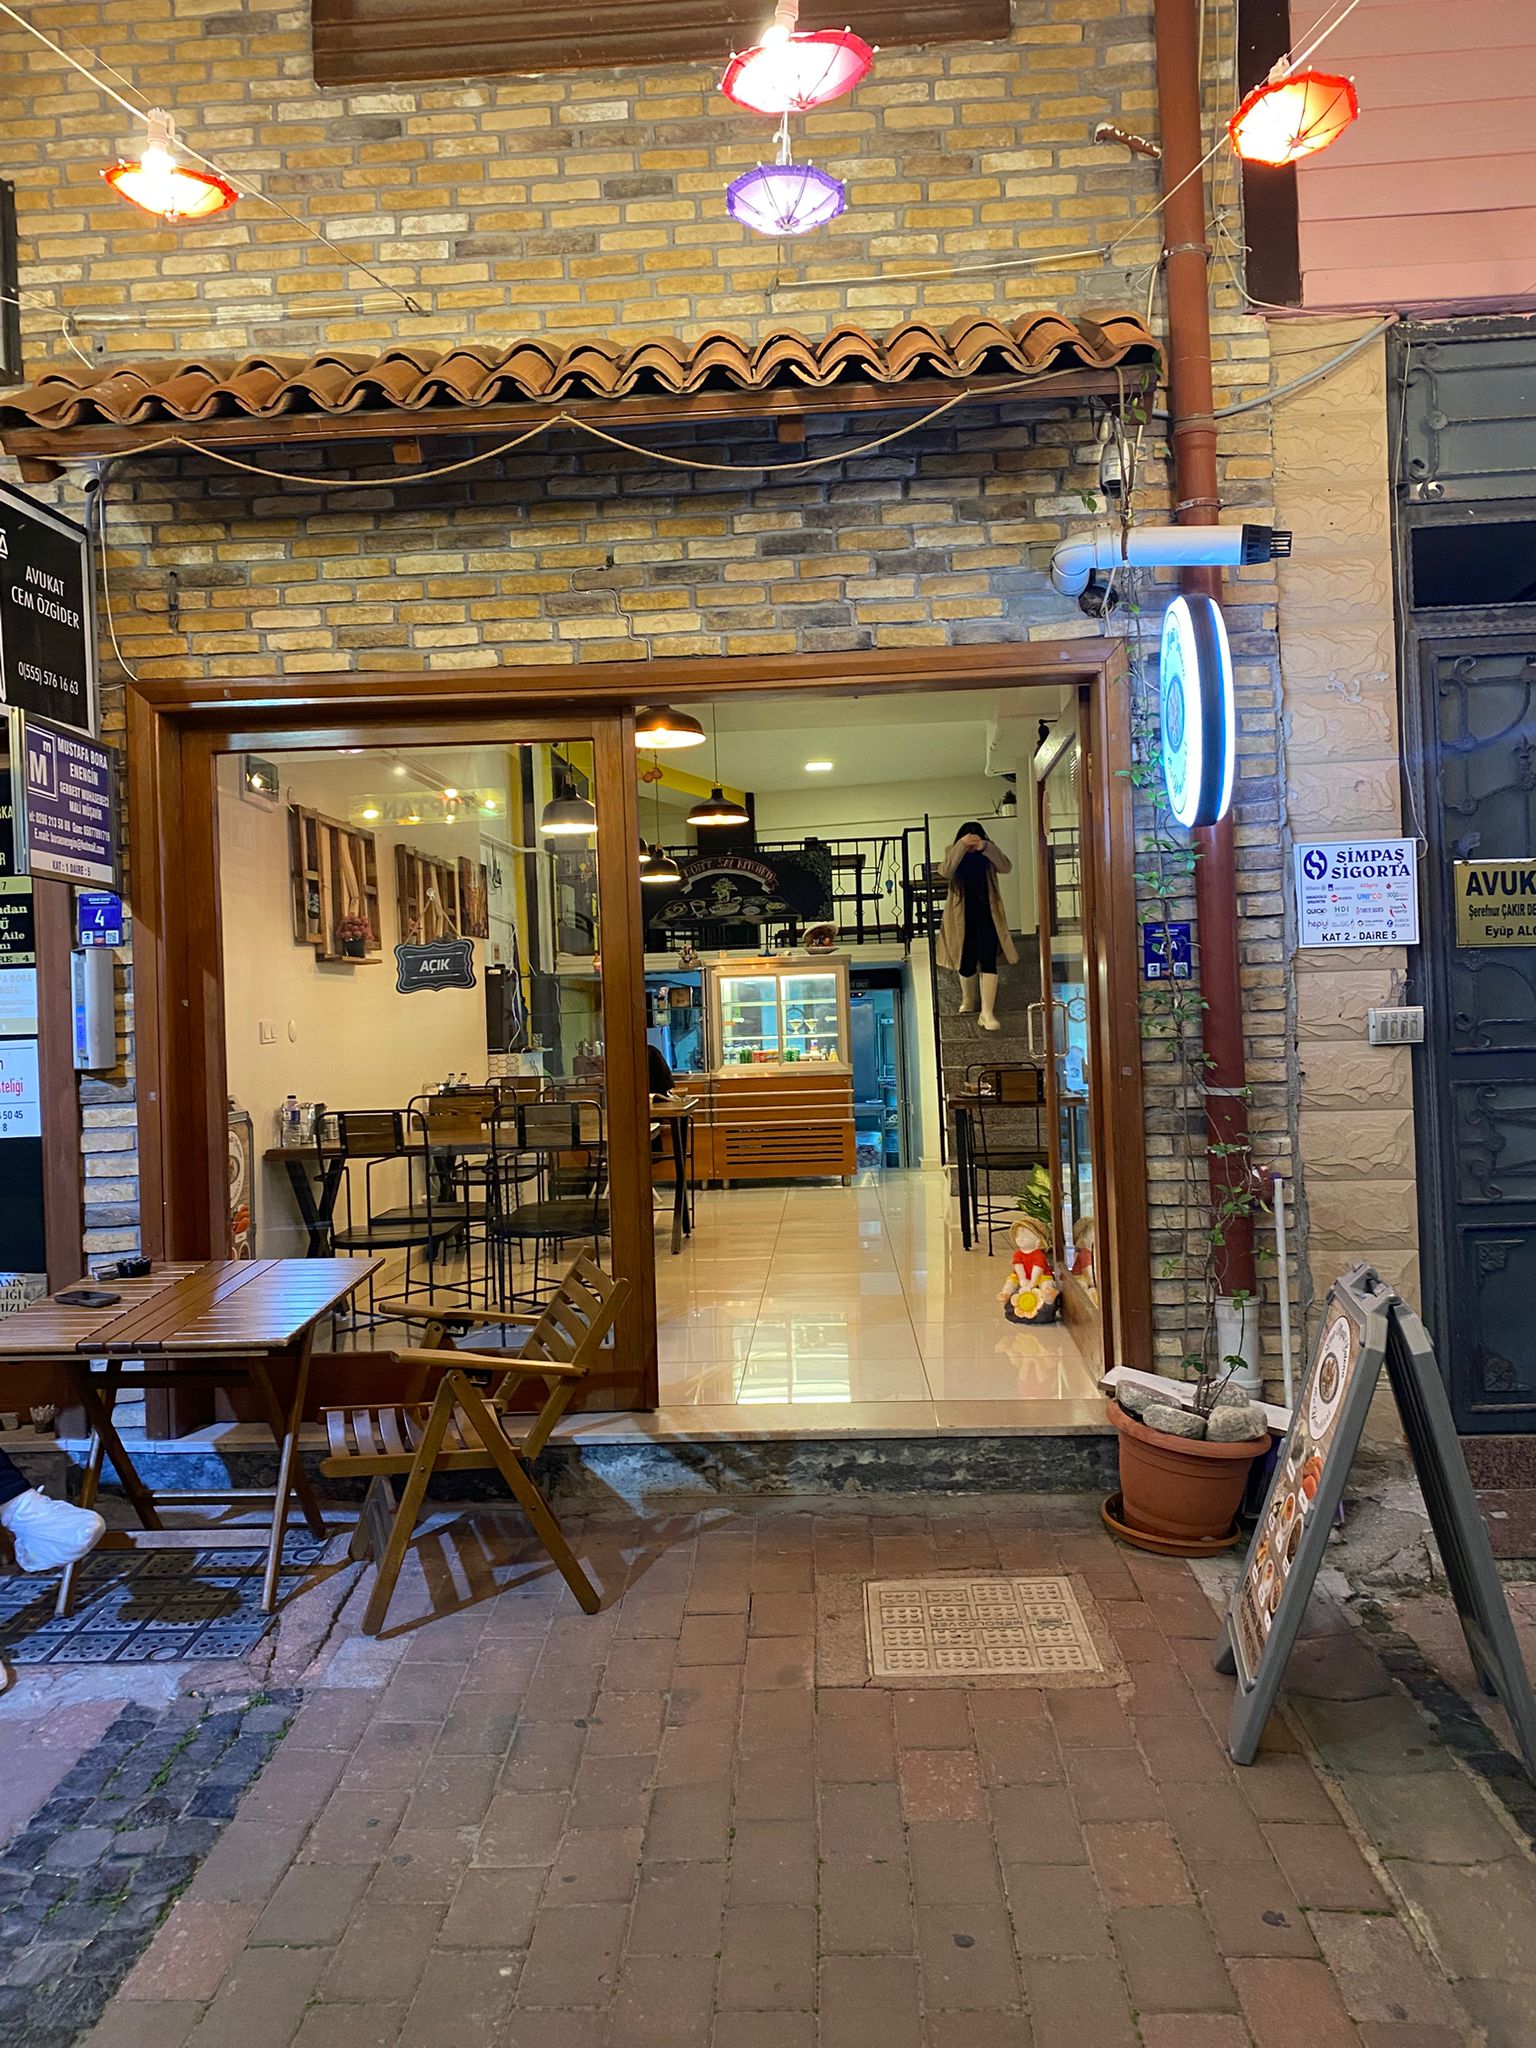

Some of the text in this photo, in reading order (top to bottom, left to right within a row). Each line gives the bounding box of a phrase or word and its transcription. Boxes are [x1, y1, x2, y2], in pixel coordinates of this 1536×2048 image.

[25, 565, 65, 597] AVUKAT
[11, 585, 80, 630] CEM ÖZGİDER
[18, 661, 79, 695] 0(555) 576 16 63
[57, 737, 108, 770] MUSTAFA BORA
[29, 750, 48, 787] M
[59, 781, 81, 798] SERBEST
[1336, 847, 1405, 865] SİMPAŞ
[52, 860, 62, 871] KAT
[1331, 863, 1411, 879] SİGORTA
[2, 881, 7, 891] 7
[94, 909, 105, 927] 4
[1501, 903, 1526, 919] ÇAKIR
[2, 931, 25, 941] Aile
[1322, 932, 1341, 942] KAT
[1344, 932, 1350, 941] 2
[1391, 931, 1397, 940] 5
[1485, 925, 1514, 938] Eyüp
[22, 954, 30, 962] 4
[419, 958, 450, 974] AÇIK
[14, 1110, 24, 1119] 45
[2, 1122, 8, 1132] 8
